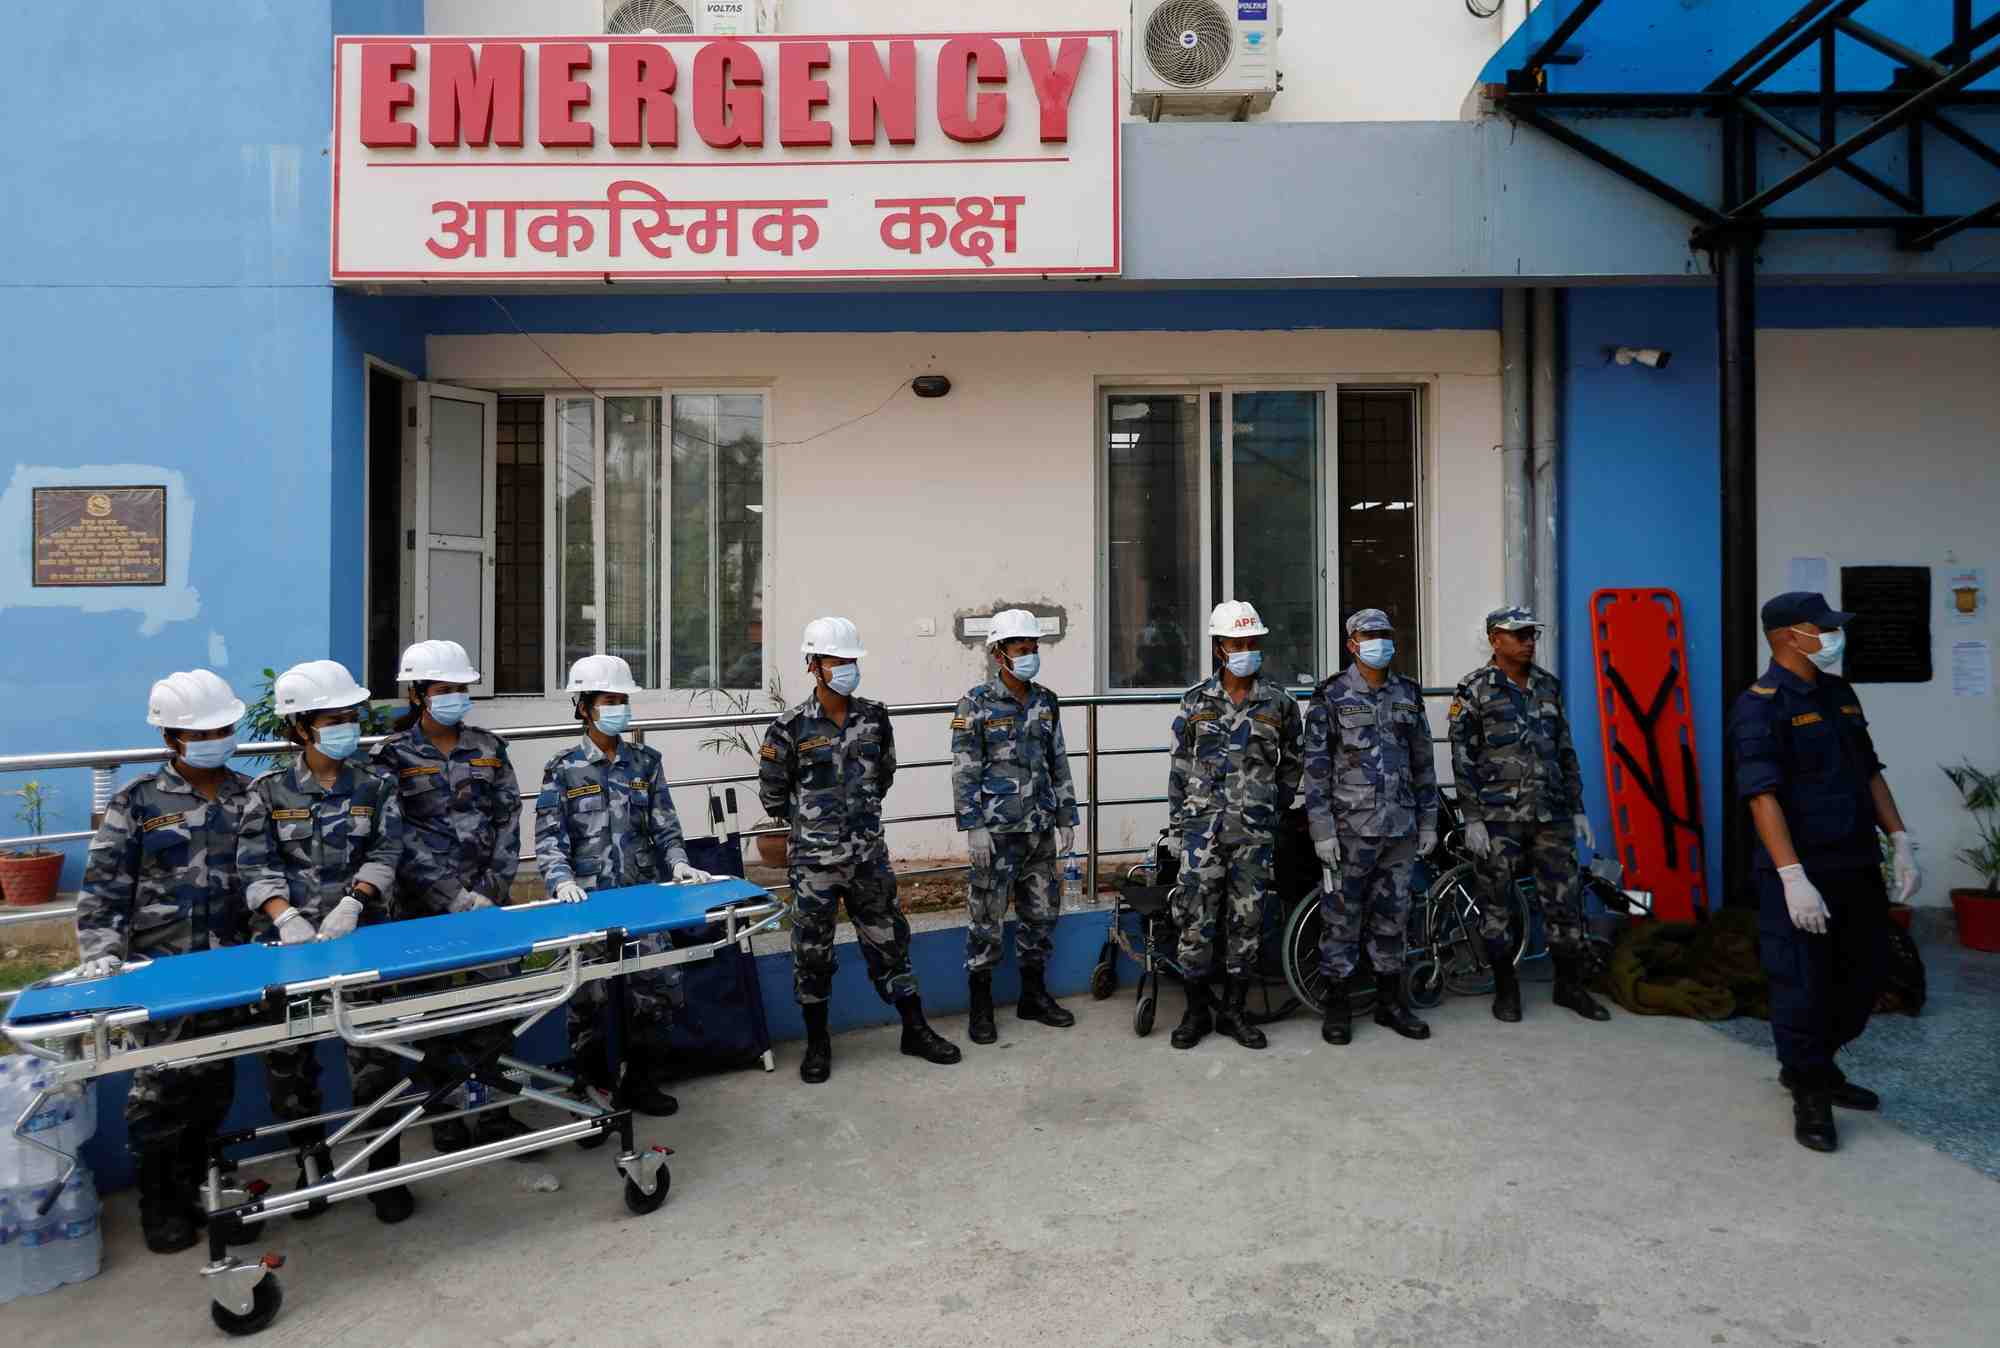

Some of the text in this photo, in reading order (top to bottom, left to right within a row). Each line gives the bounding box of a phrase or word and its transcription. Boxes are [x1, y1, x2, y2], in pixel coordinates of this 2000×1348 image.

[707, 4, 743, 12] VOLTAS
[360, 37, 1089, 148] EMERGENCY
[425, 180, 1026, 266] आकस्मिक कक्ष
